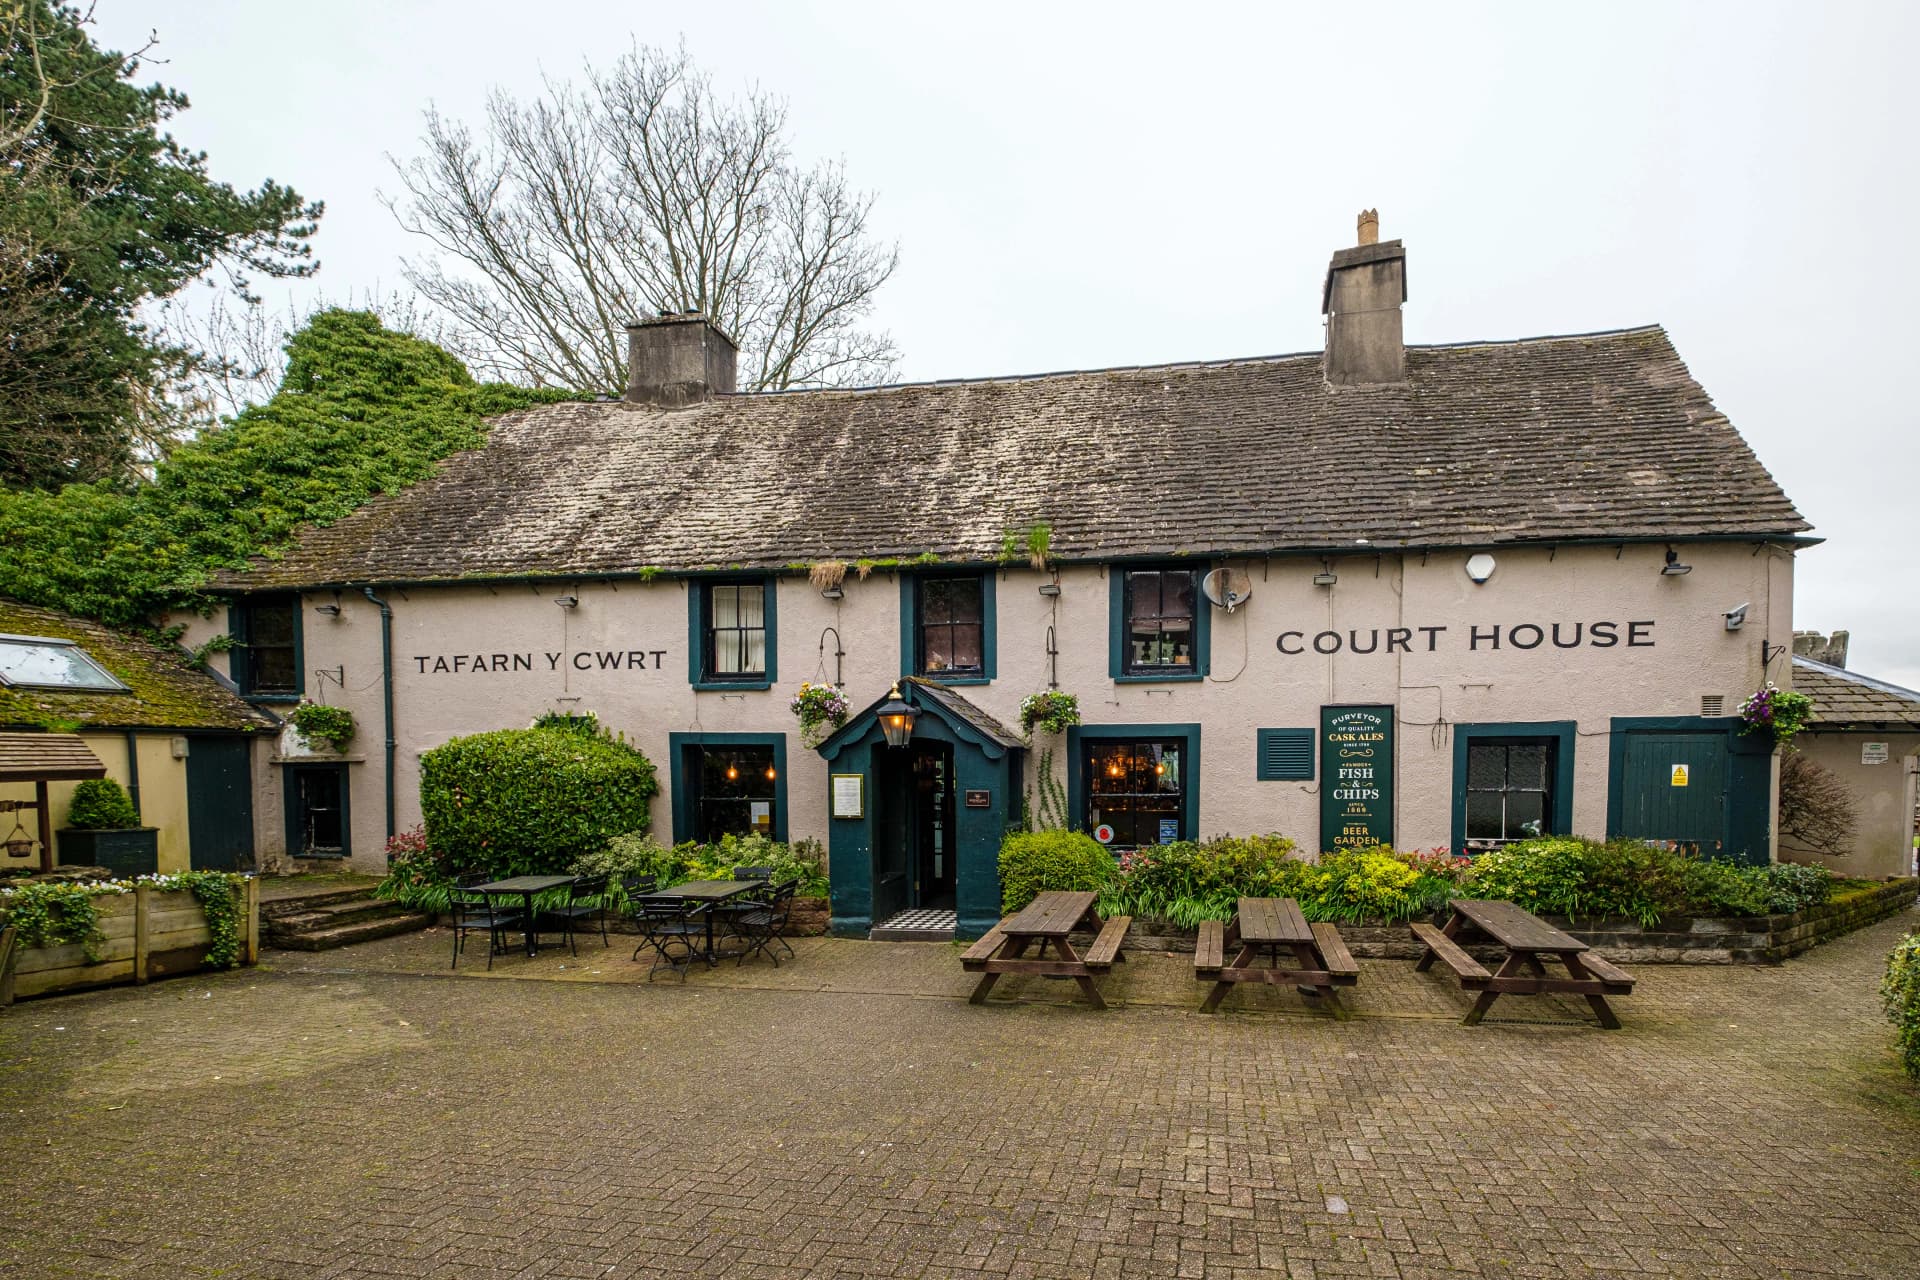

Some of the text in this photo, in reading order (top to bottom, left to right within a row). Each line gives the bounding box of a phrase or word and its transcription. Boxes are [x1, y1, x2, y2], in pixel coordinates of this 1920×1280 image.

[1276, 620, 1656, 654] COURT HOUSE
[414, 650, 667, 673] TAFARN Y CWRT
[1331, 713, 1382, 725] PURVEYOR
[1328, 732, 1384, 741] CASK ALES
[1338, 768, 1374, 779] FISH
[1352, 780, 1361, 788] &
[1333, 789, 1379, 800] CHIPS
[1343, 827, 1369, 835] BEER
[1333, 836, 1379, 845] GARDEN
